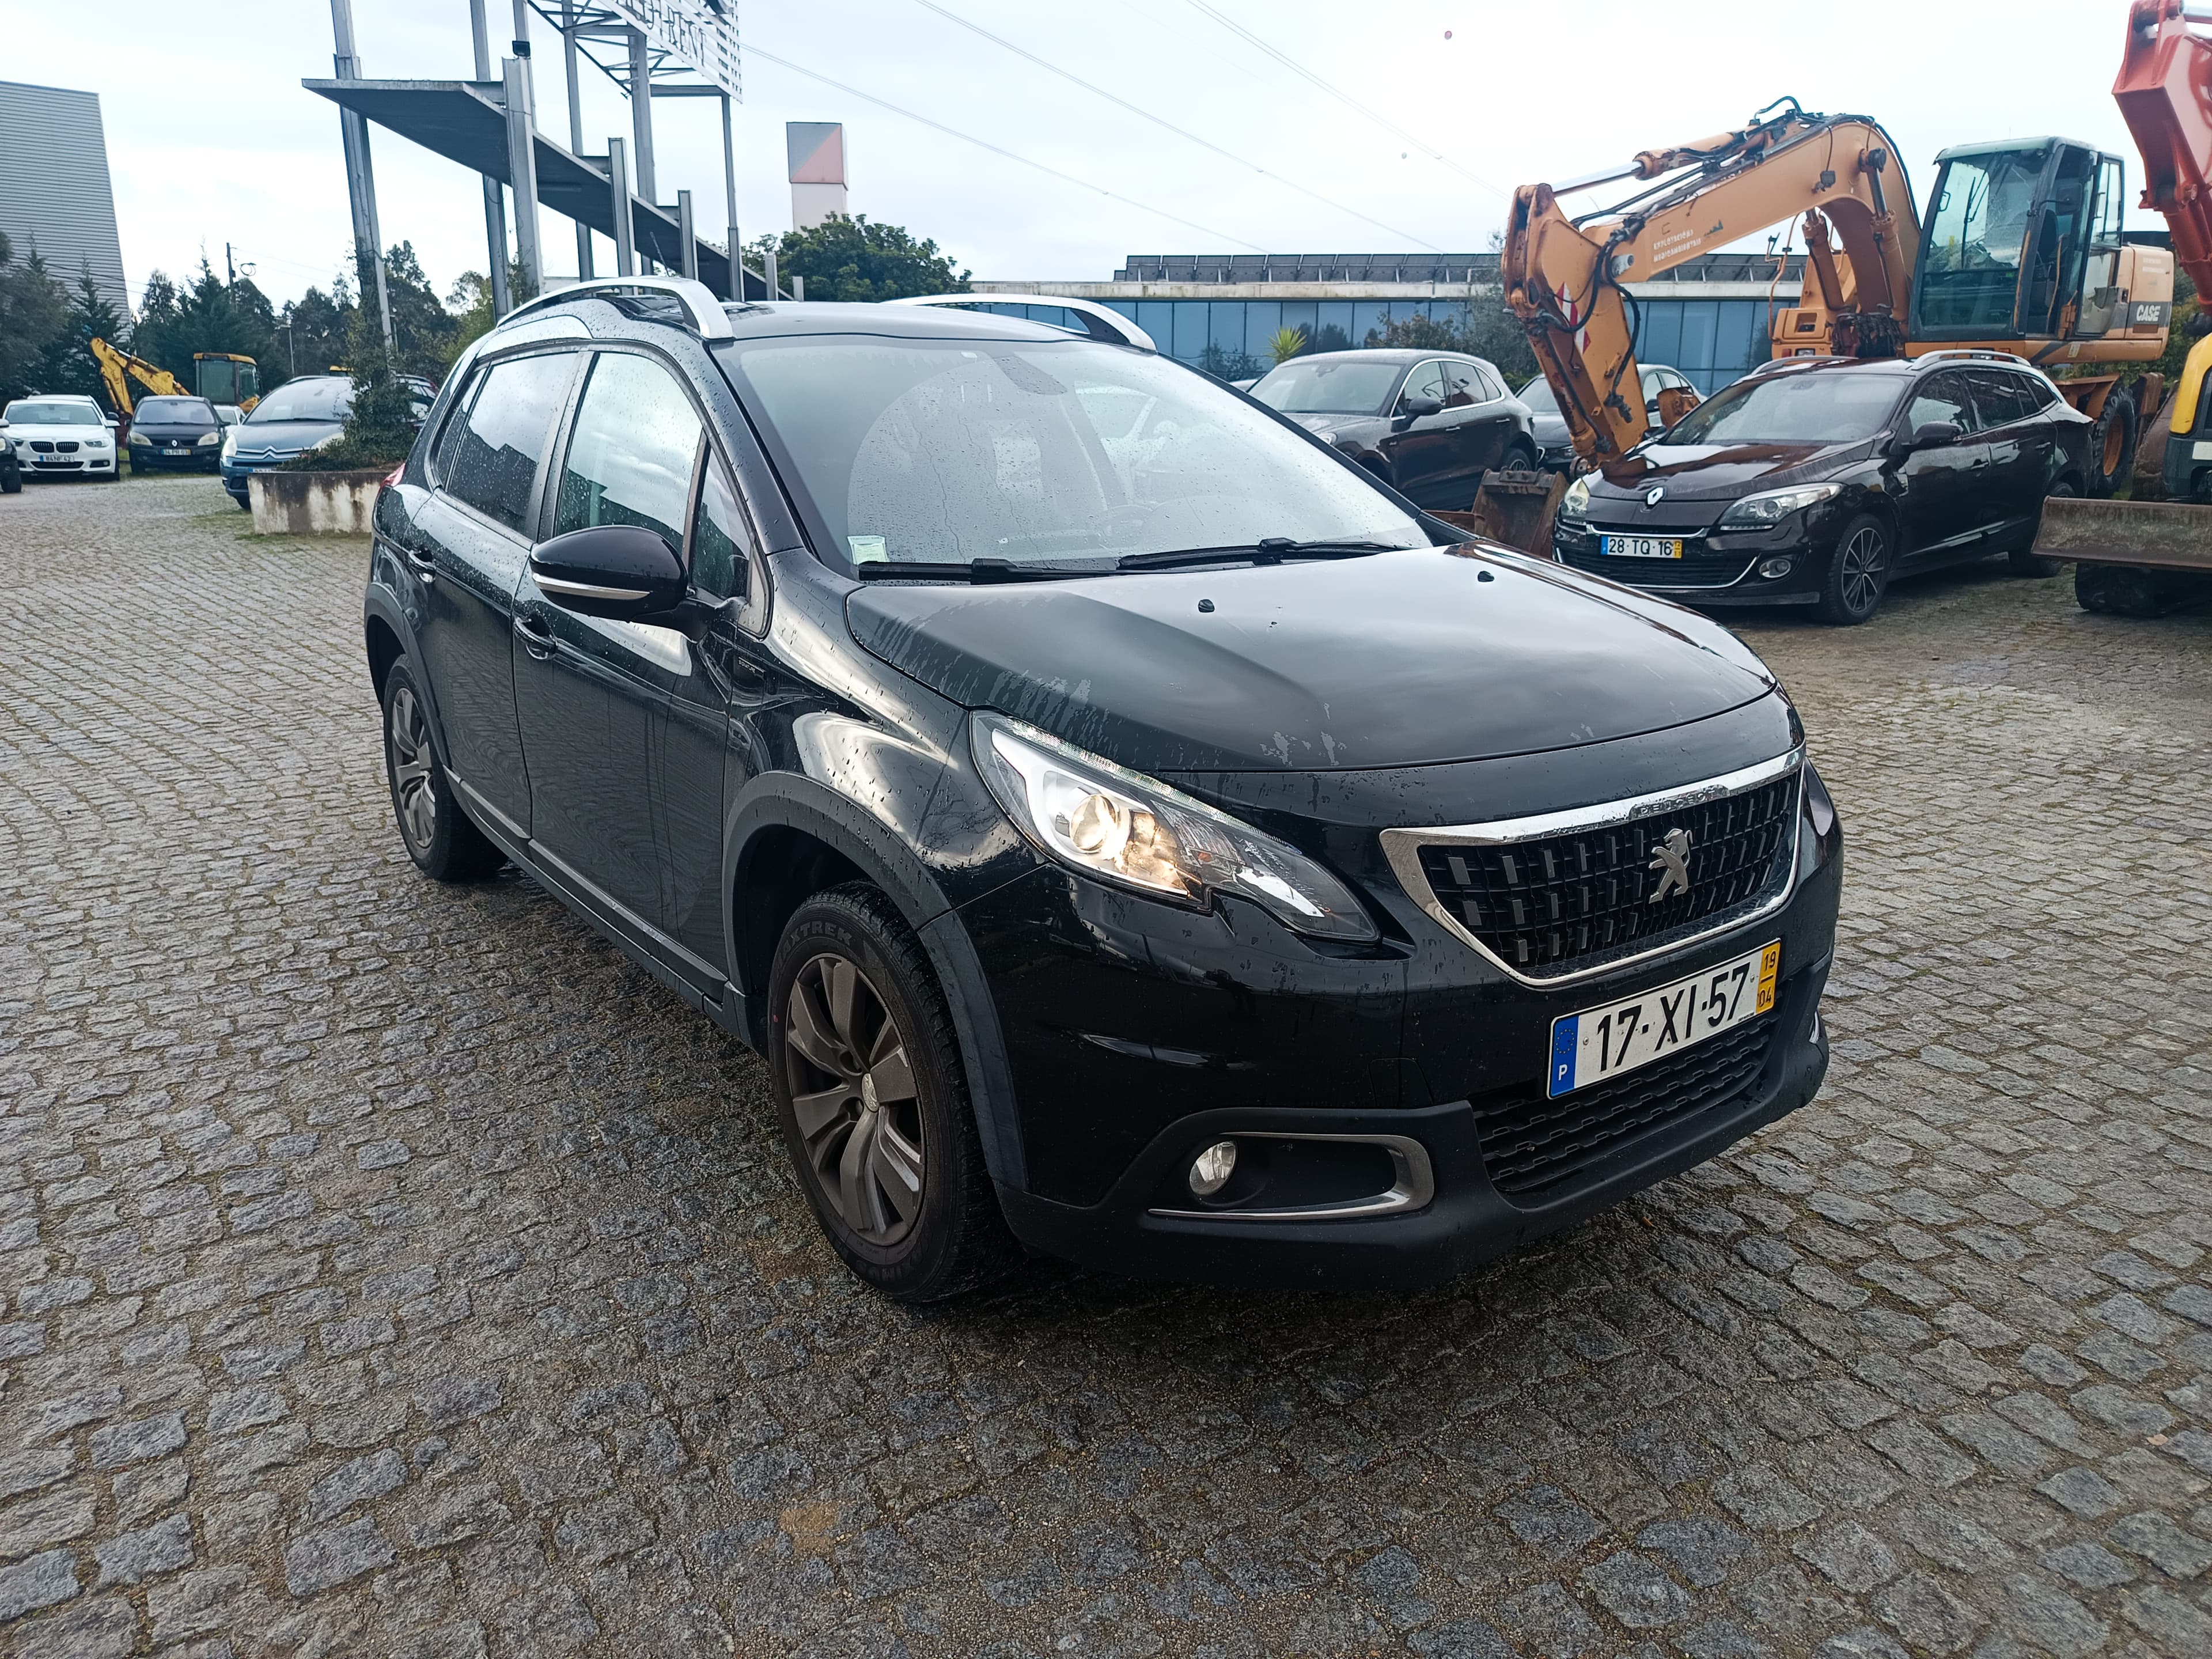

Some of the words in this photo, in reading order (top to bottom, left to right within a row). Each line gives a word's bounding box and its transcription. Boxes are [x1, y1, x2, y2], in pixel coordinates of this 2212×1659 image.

[2136, 304, 2161, 322] CASE
[1764, 950, 1777, 972] 19
[1757, 988, 1772, 1008] 04
[1558, 1063, 1568, 1081] P
